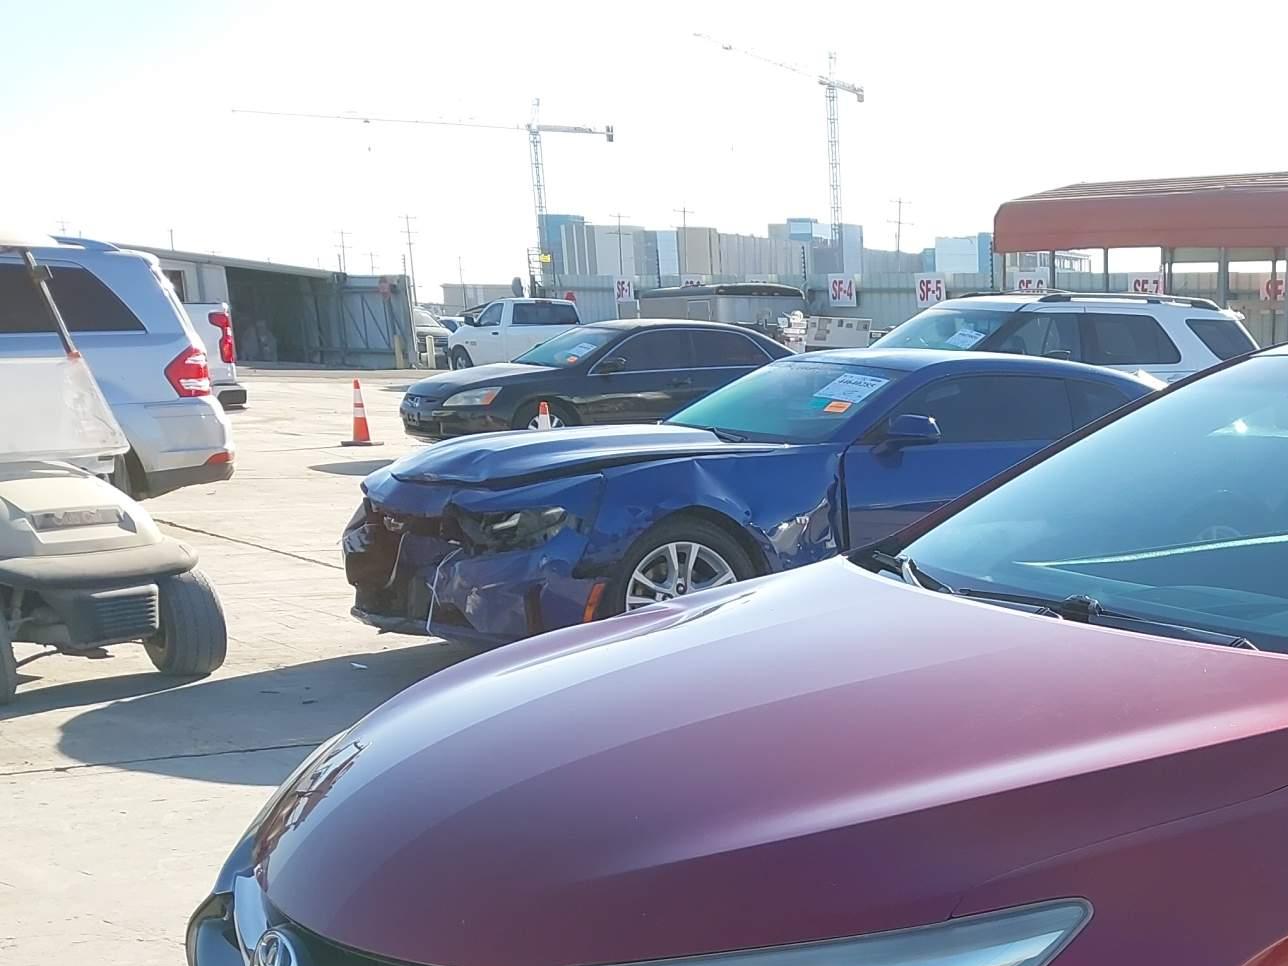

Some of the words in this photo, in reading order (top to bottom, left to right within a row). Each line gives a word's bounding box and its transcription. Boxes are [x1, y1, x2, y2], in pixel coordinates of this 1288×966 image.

[616, 281, 631, 298] SF-1
[832, 280, 853, 300] SF-4
[919, 280, 942, 300] SF-5
